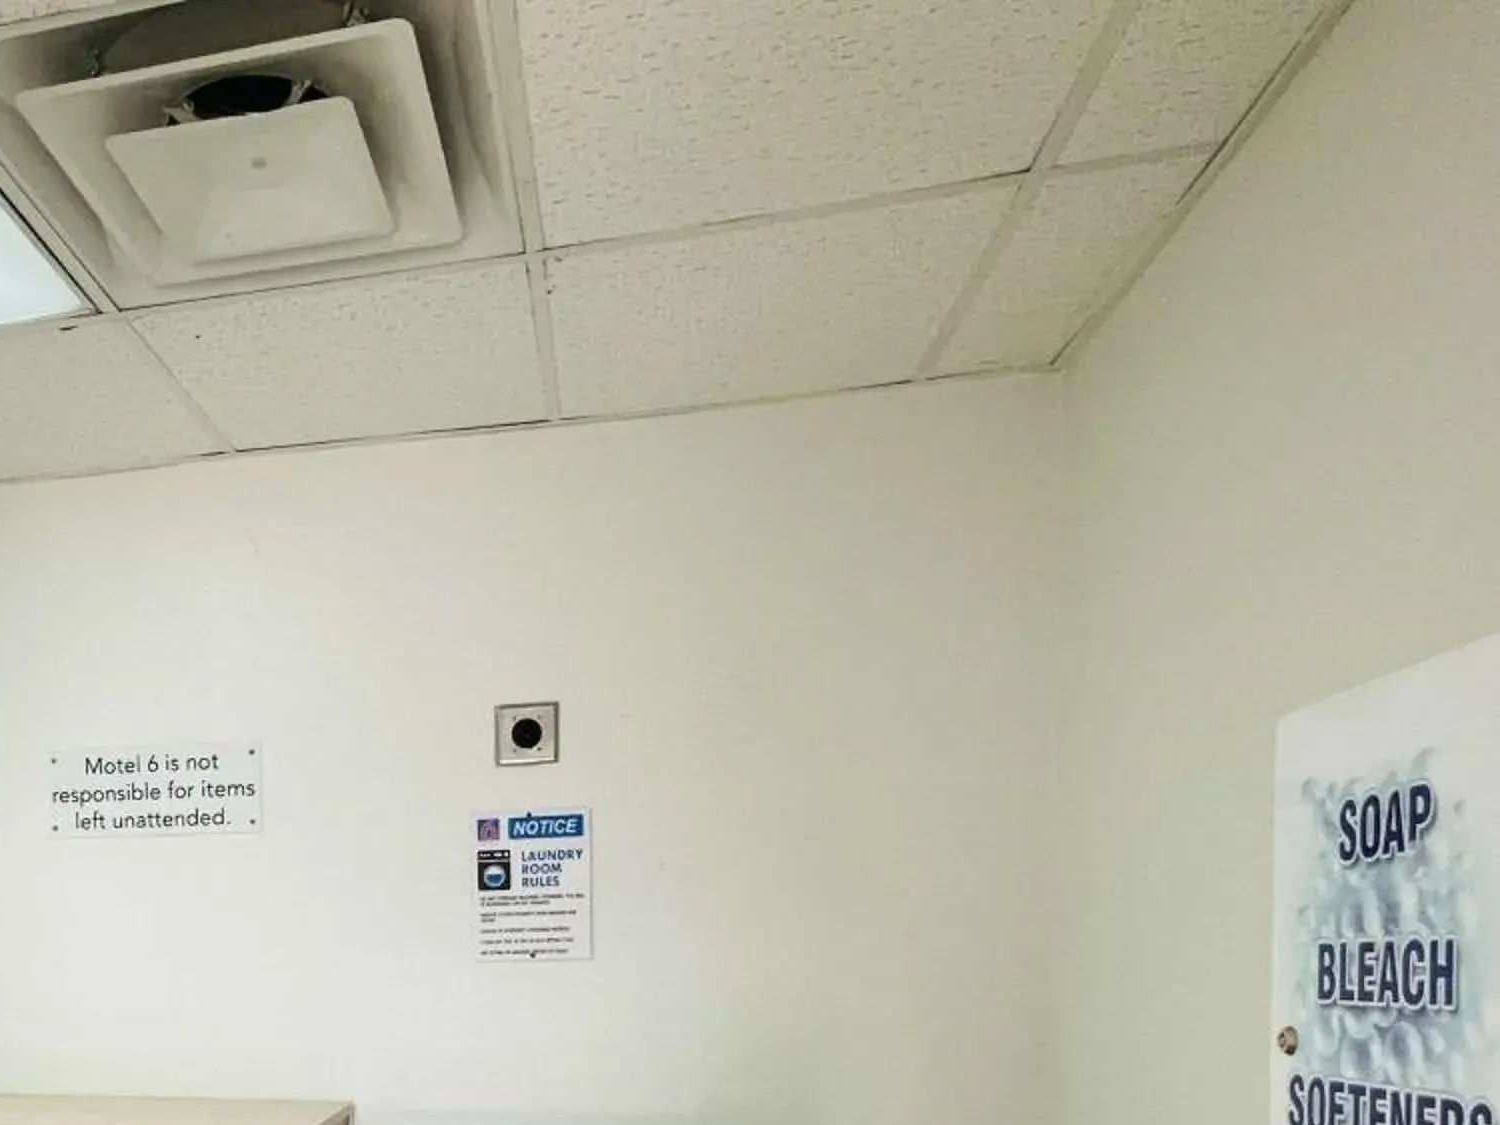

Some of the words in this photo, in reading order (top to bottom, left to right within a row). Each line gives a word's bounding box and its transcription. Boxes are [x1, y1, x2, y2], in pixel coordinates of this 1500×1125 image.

[84, 754, 141, 775] Motel
[147, 754, 160, 774] 6
[165, 753, 179, 772] is
[186, 754, 220, 771] not
[51, 782, 161, 807] responsible
[168, 780, 195, 800] for
[201, 779, 256, 799] items
[74, 811, 106, 831] left
[112, 808, 232, 830] unattended.
[512, 818, 578, 837] NOTICE
[1337, 783, 1433, 862] SOAP
[521, 849, 584, 861] LAUNDRY
[521, 863, 562, 875] ROOM
[521, 876, 561, 888] RULES
[1316, 938, 1456, 1007] BLEACH
